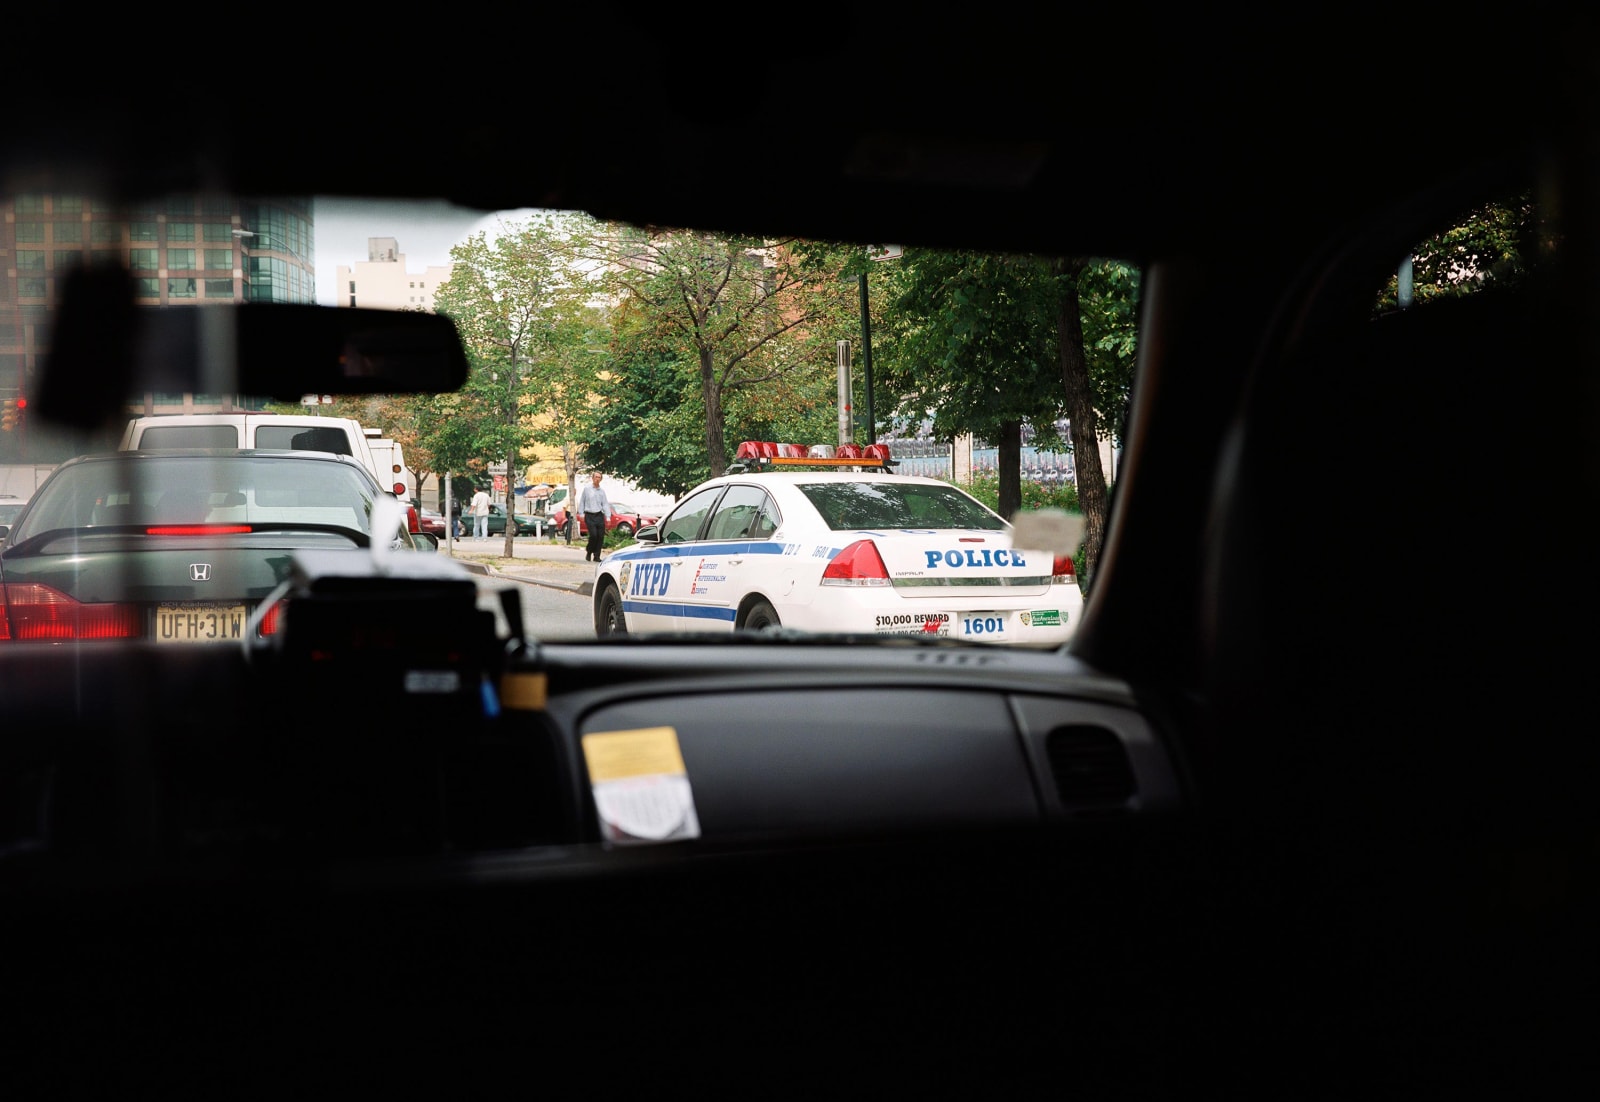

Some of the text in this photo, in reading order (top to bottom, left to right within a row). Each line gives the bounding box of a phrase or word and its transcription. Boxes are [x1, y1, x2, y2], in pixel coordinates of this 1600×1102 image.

[811, 545, 829, 558] 1601
[924, 549, 1026, 568] POLICE
[630, 563, 671, 596] NYPD
[875, 613, 950, 626] $10,000 REWARD
[964, 617, 1004, 634] 1601
